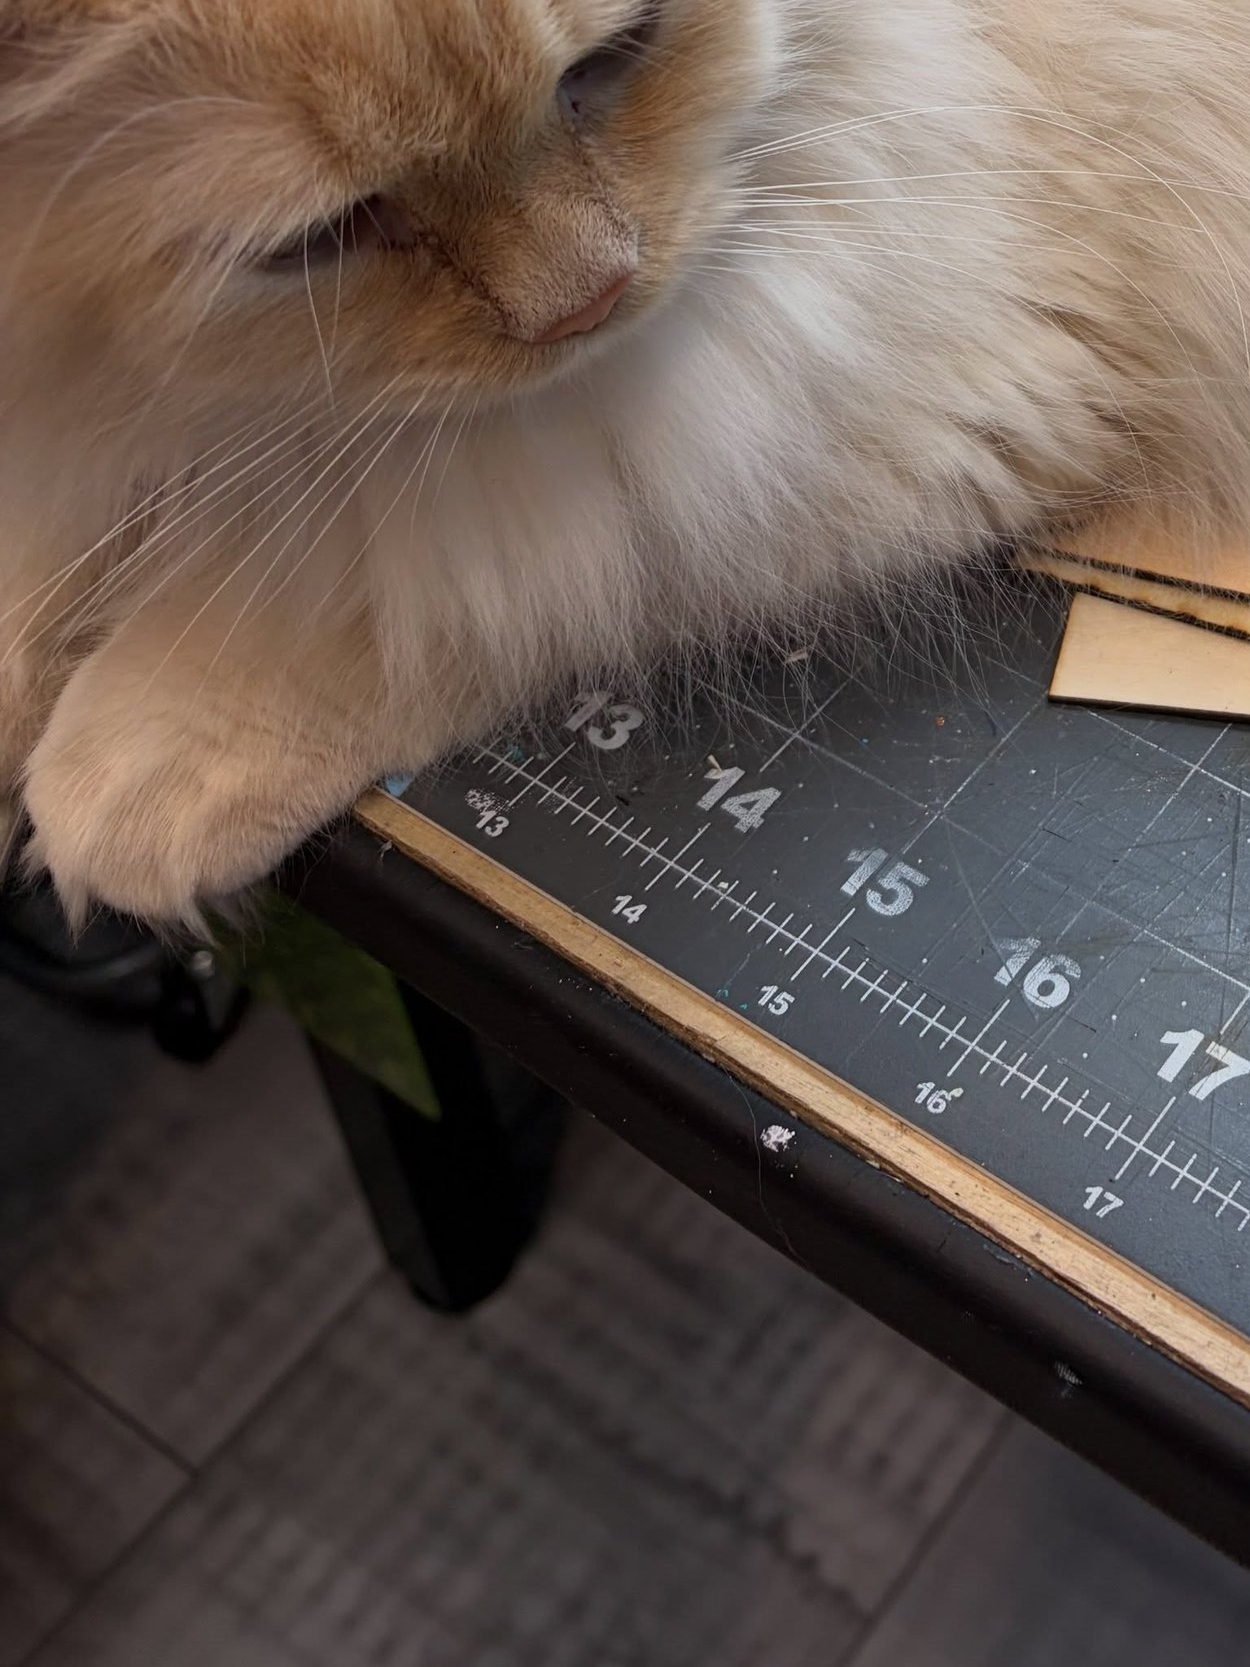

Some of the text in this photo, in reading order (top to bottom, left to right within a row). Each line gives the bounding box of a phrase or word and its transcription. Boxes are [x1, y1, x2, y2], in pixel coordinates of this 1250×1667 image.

[563, 690, 646, 751] 13
[696, 765, 782, 833] 14
[475, 808, 505, 838] 13
[840, 846, 930, 917] 15
[611, 894, 647, 925] 14
[992, 935, 1083, 1009] 16
[758, 984, 796, 1016] 15
[914, 1080, 952, 1115] 16
[1083, 1184, 1124, 1219] 17
